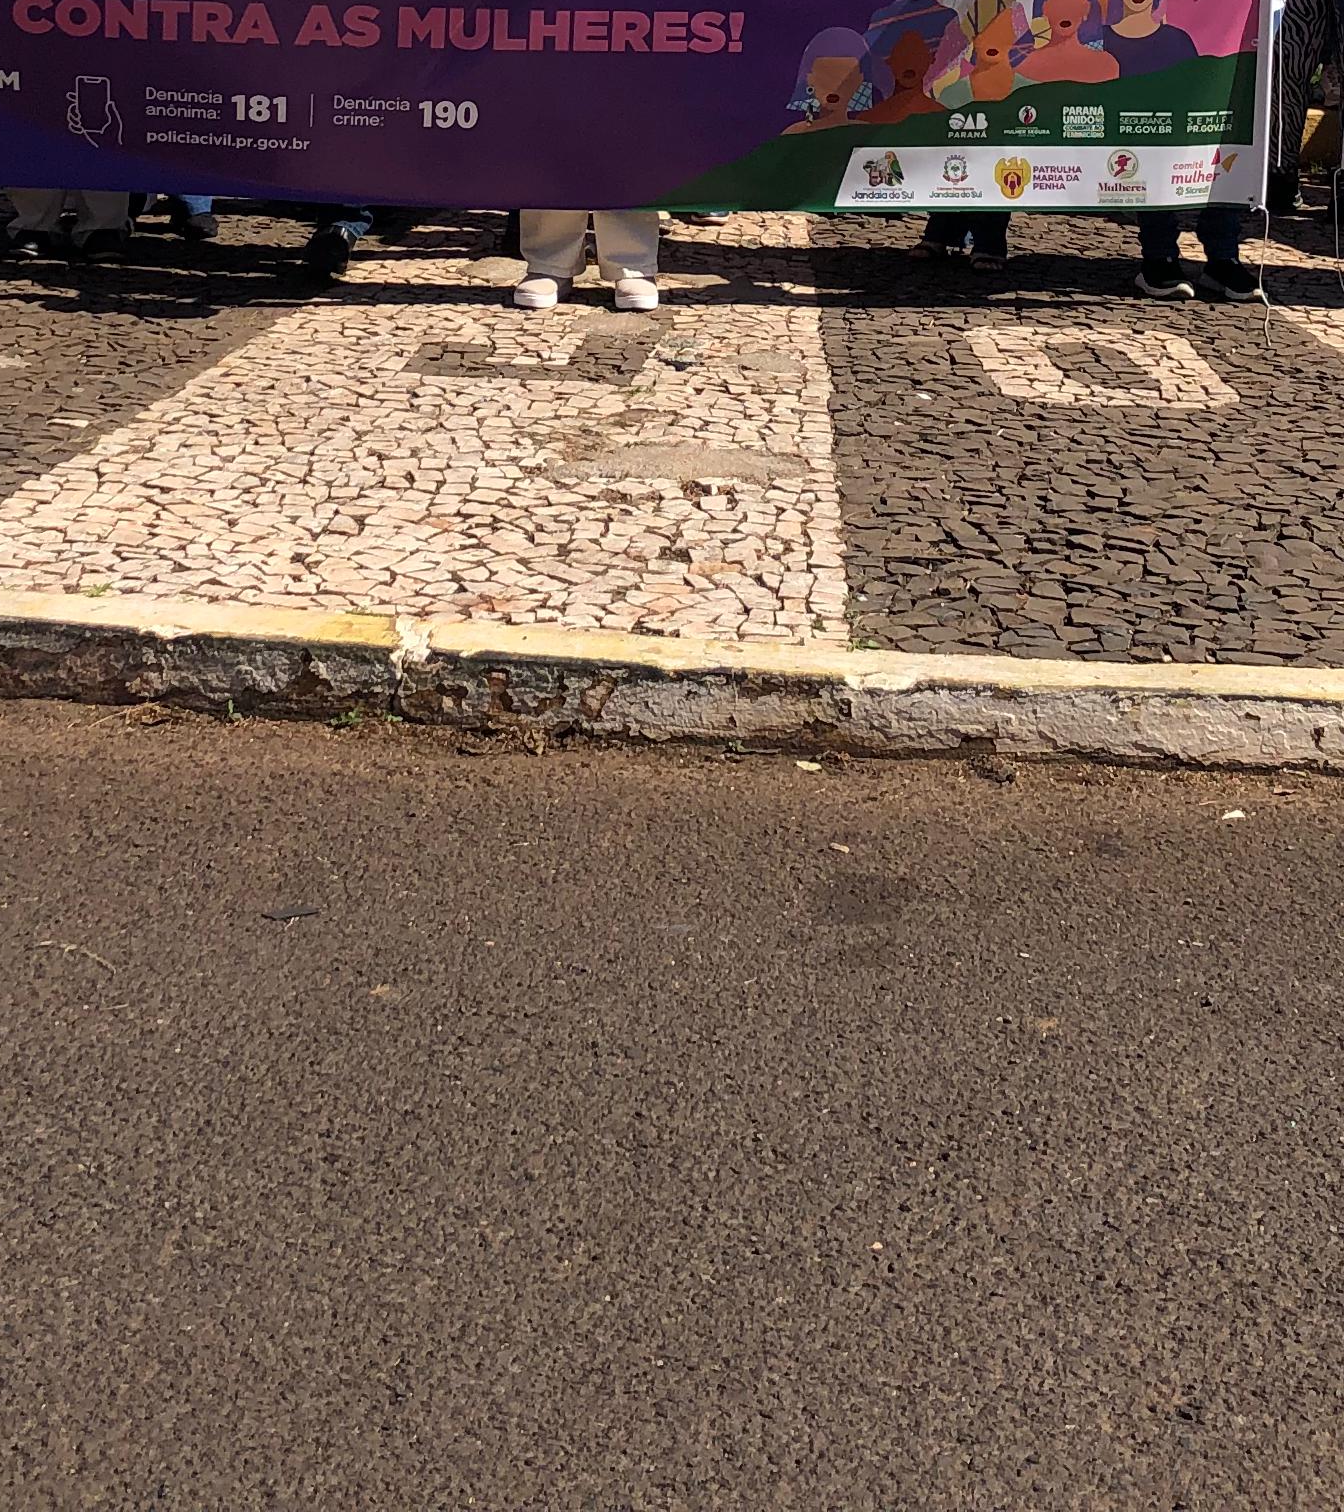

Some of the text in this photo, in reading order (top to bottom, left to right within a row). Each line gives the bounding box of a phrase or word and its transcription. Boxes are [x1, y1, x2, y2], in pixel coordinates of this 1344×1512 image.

[294, 3, 381, 48] AS
[397, 6, 745, 54] MULHERES!
[145, 86, 223, 105] Denúncia
[231, 94, 288, 124] 181
[333, 95, 411, 113] Denúncia
[145, 102, 222, 121] anônima:
[418, 100, 480, 129] 190
[1062, 105, 1104, 116] PARANÁ
[333, 112, 385, 128] crime:
[948, 112, 989, 130] OAB
[1062, 116, 1095, 125] UNIDO
[1119, 117, 1173, 126] SEGURANÇA
[947, 130, 988, 139] PARANÁ
[1119, 125, 1173, 134] PR.GOV.BR
[1186, 124, 1233, 134] PR.GOV.BR
[145, 129, 311, 152] policiacivil.pr.gov.br
[1032, 165, 1083, 175] PATRULHA
[1032, 174, 1080, 183] MARIA DA
[1170, 171, 1221, 185] mulher
[1032, 182, 1067, 191] PENHA
[1098, 182, 1147, 193] Mulheres
[851, 190, 915, 200] Jandaia do Sul
[928, 190, 983, 199] Jandaia do Sul
